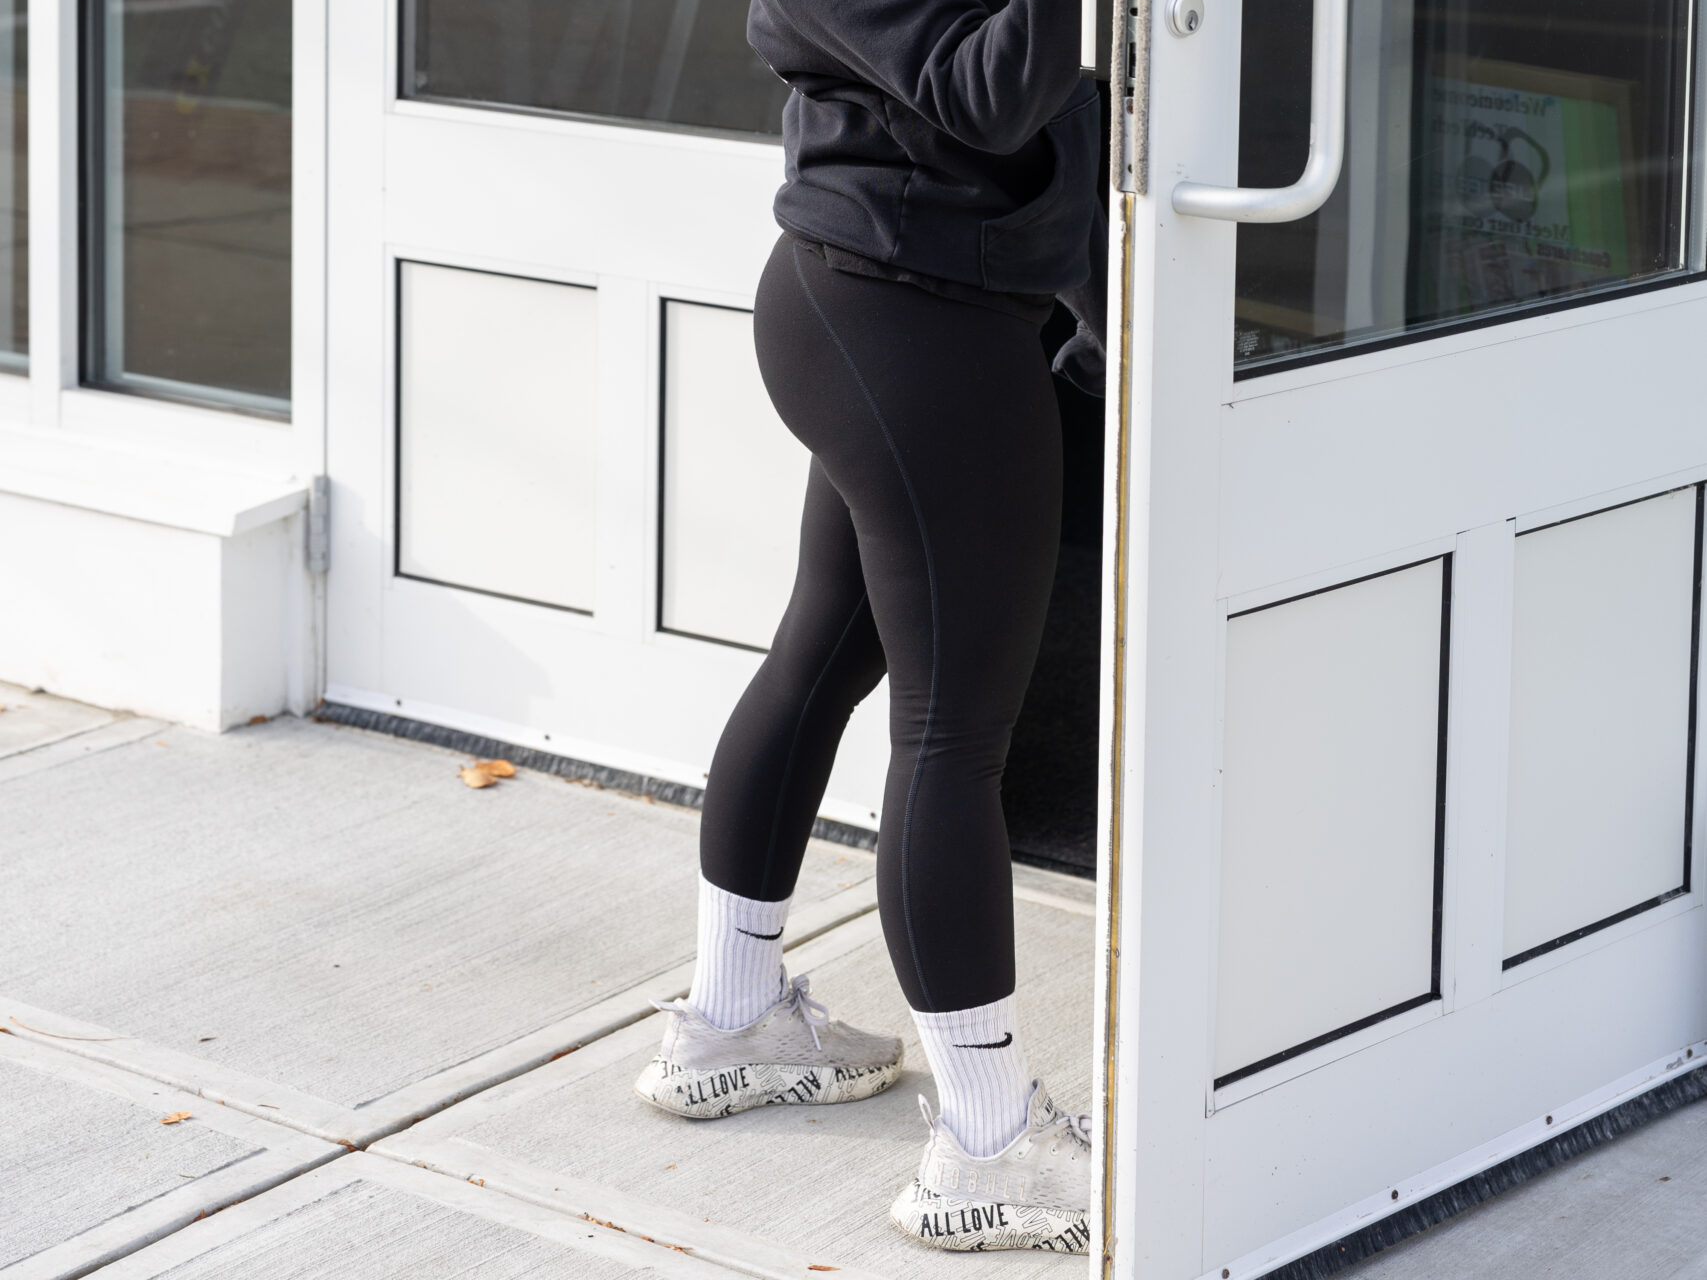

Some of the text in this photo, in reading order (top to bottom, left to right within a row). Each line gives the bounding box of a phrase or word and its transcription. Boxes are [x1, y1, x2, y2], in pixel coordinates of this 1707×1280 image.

[711, 1067, 750, 1098] LOVE
[921, 1204, 1009, 1238] ALL LOVE
